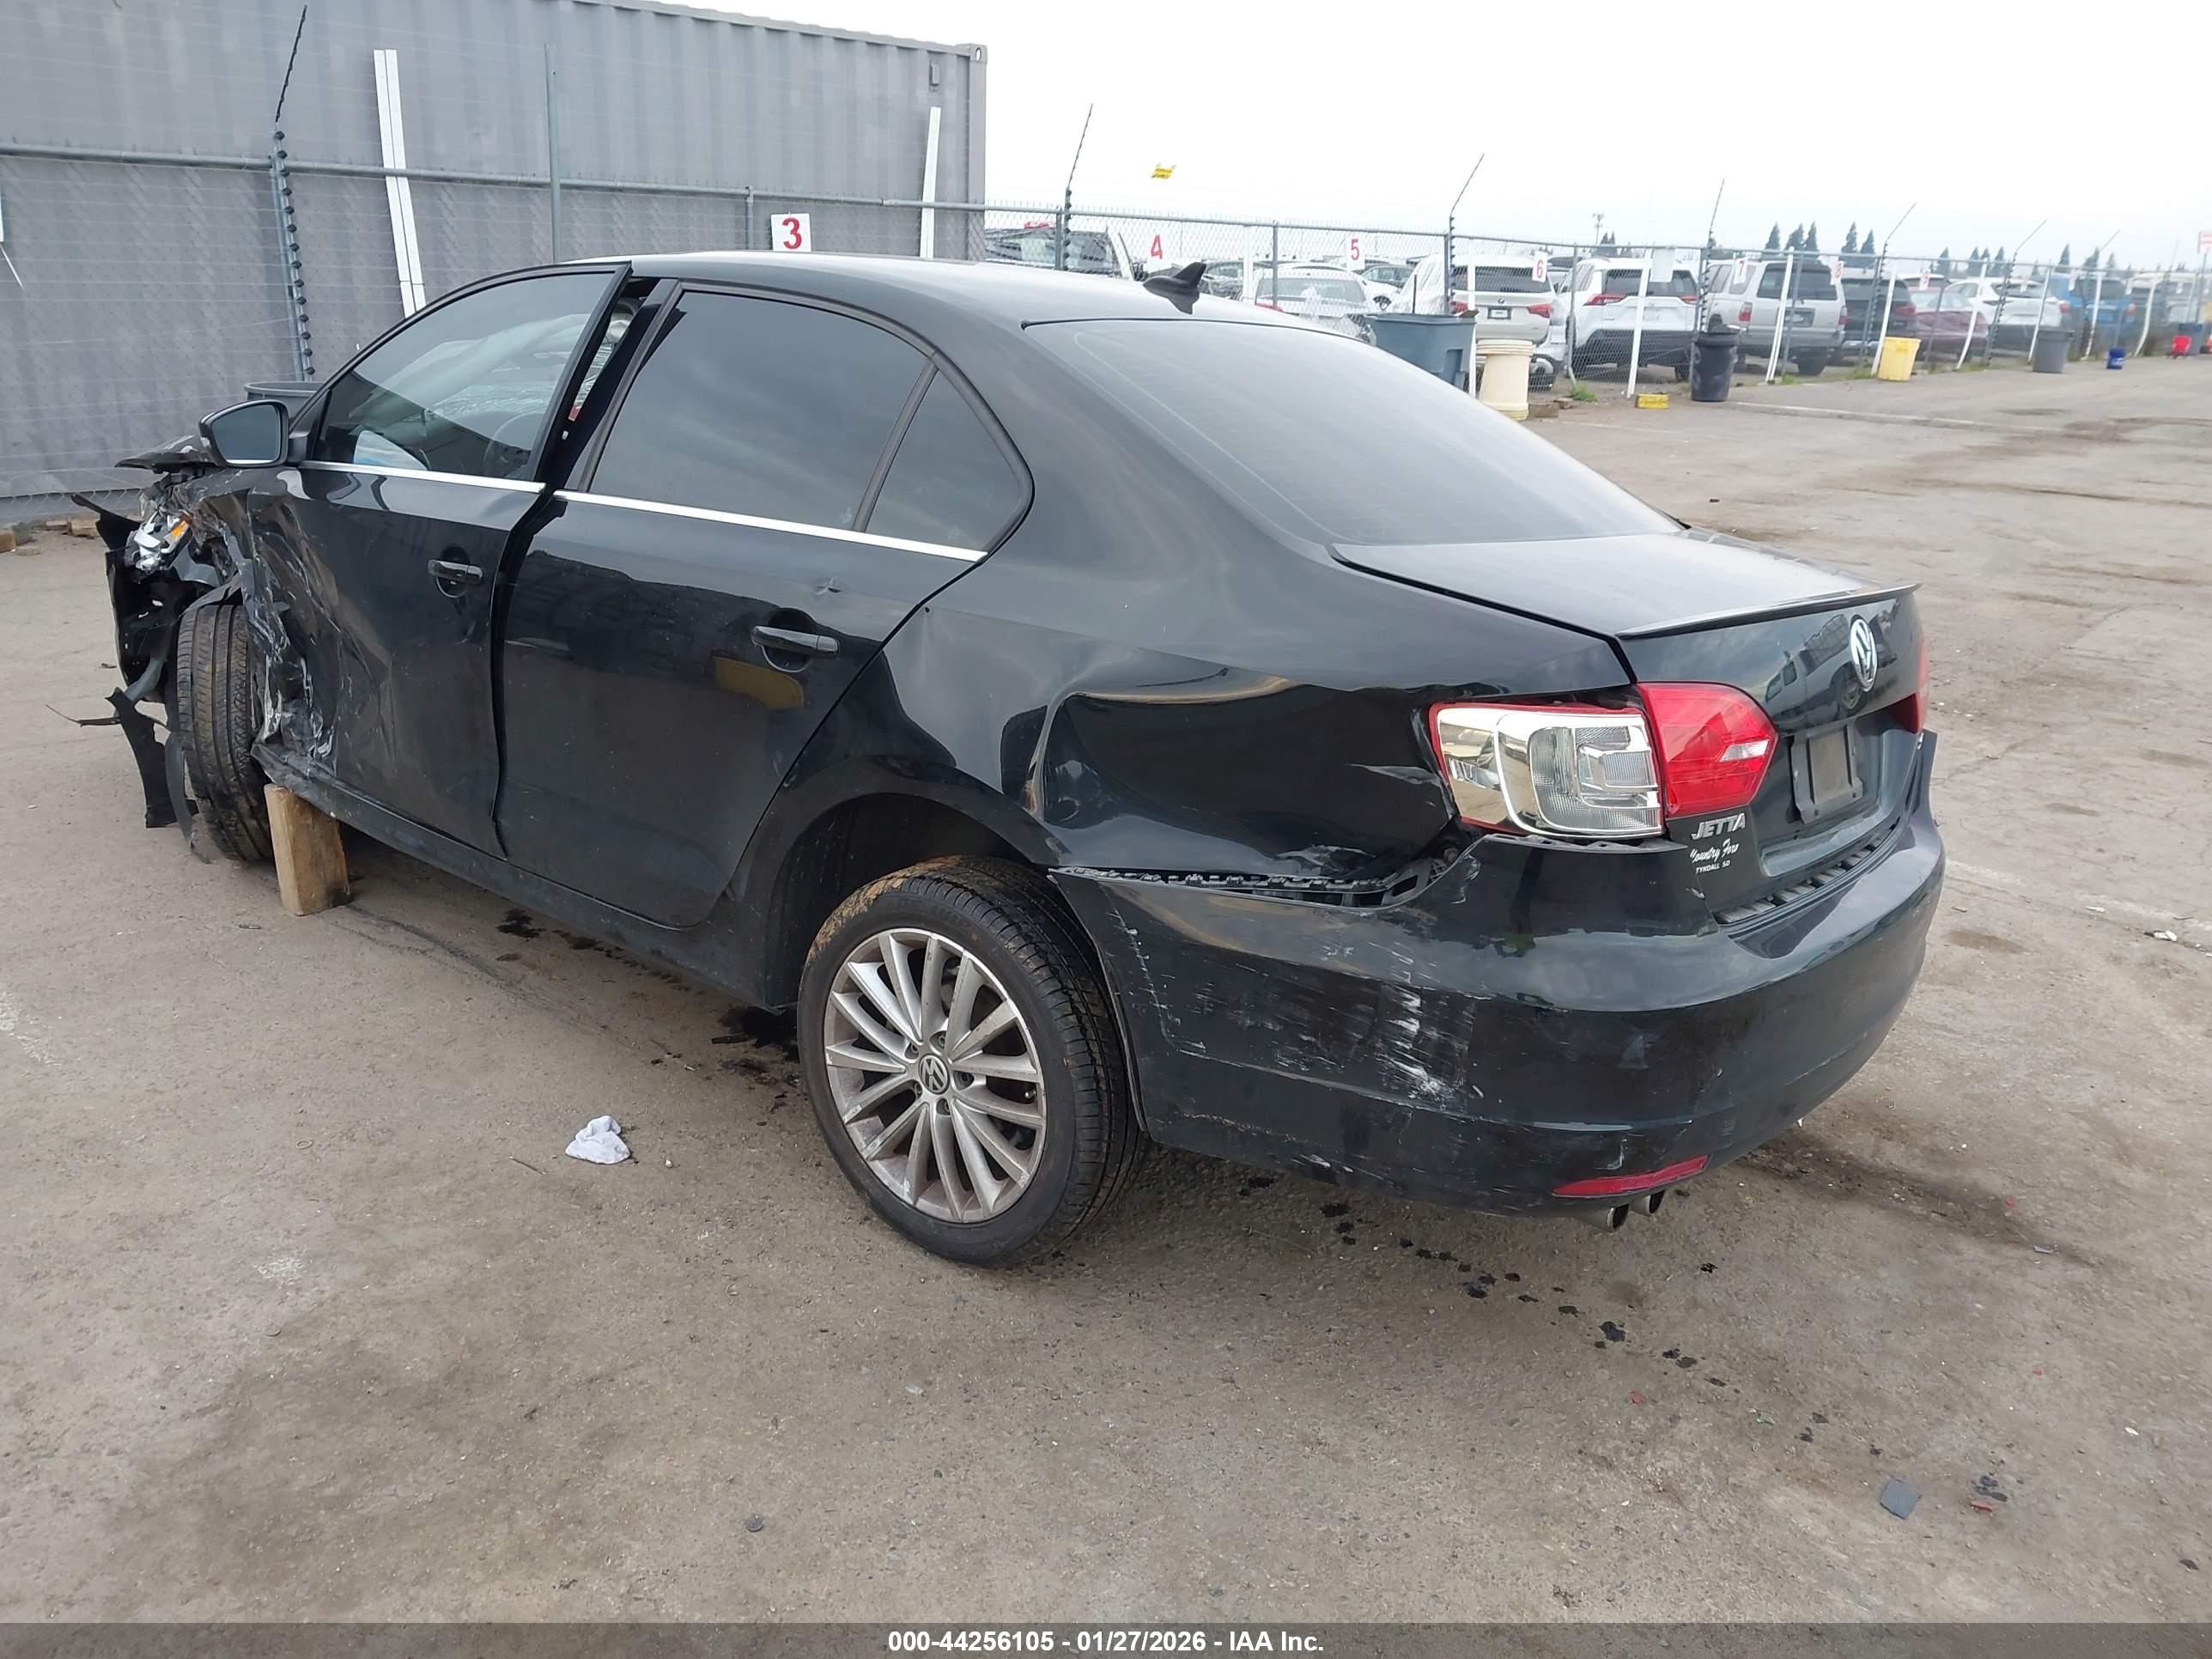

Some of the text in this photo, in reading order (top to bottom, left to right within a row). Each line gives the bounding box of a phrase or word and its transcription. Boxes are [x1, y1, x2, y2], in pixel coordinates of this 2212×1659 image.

[781, 217, 803, 250] 3
[1151, 234, 1164, 259] 4
[1351, 238, 1360, 261] 5
[1537, 258, 1545, 279] 6
[1739, 260, 1746, 276] 7
[1690, 812, 1747, 841] JETTA
